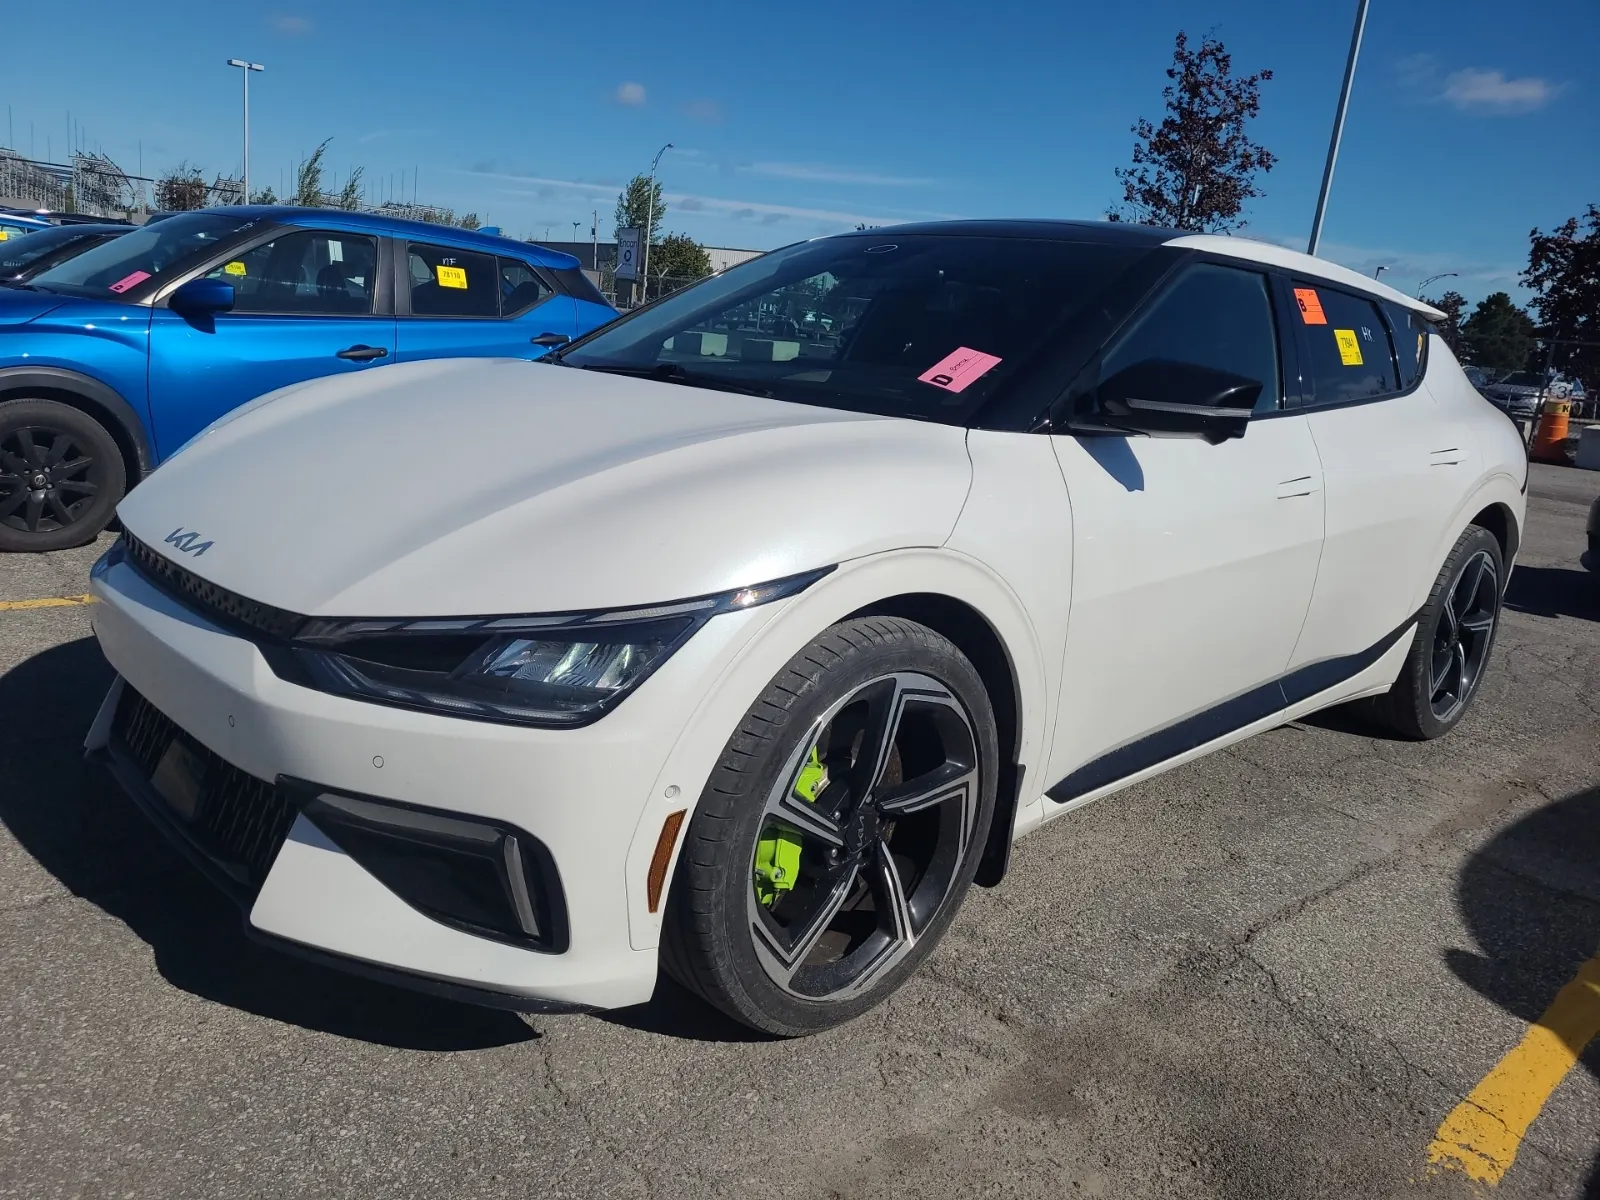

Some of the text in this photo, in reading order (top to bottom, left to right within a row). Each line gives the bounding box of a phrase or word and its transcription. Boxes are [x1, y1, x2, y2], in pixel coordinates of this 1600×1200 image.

[1297, 298, 1308, 312] B
[930, 374, 954, 386] D
[1556, 386, 1568, 399] 3
[164, 527, 215, 558] KIA
